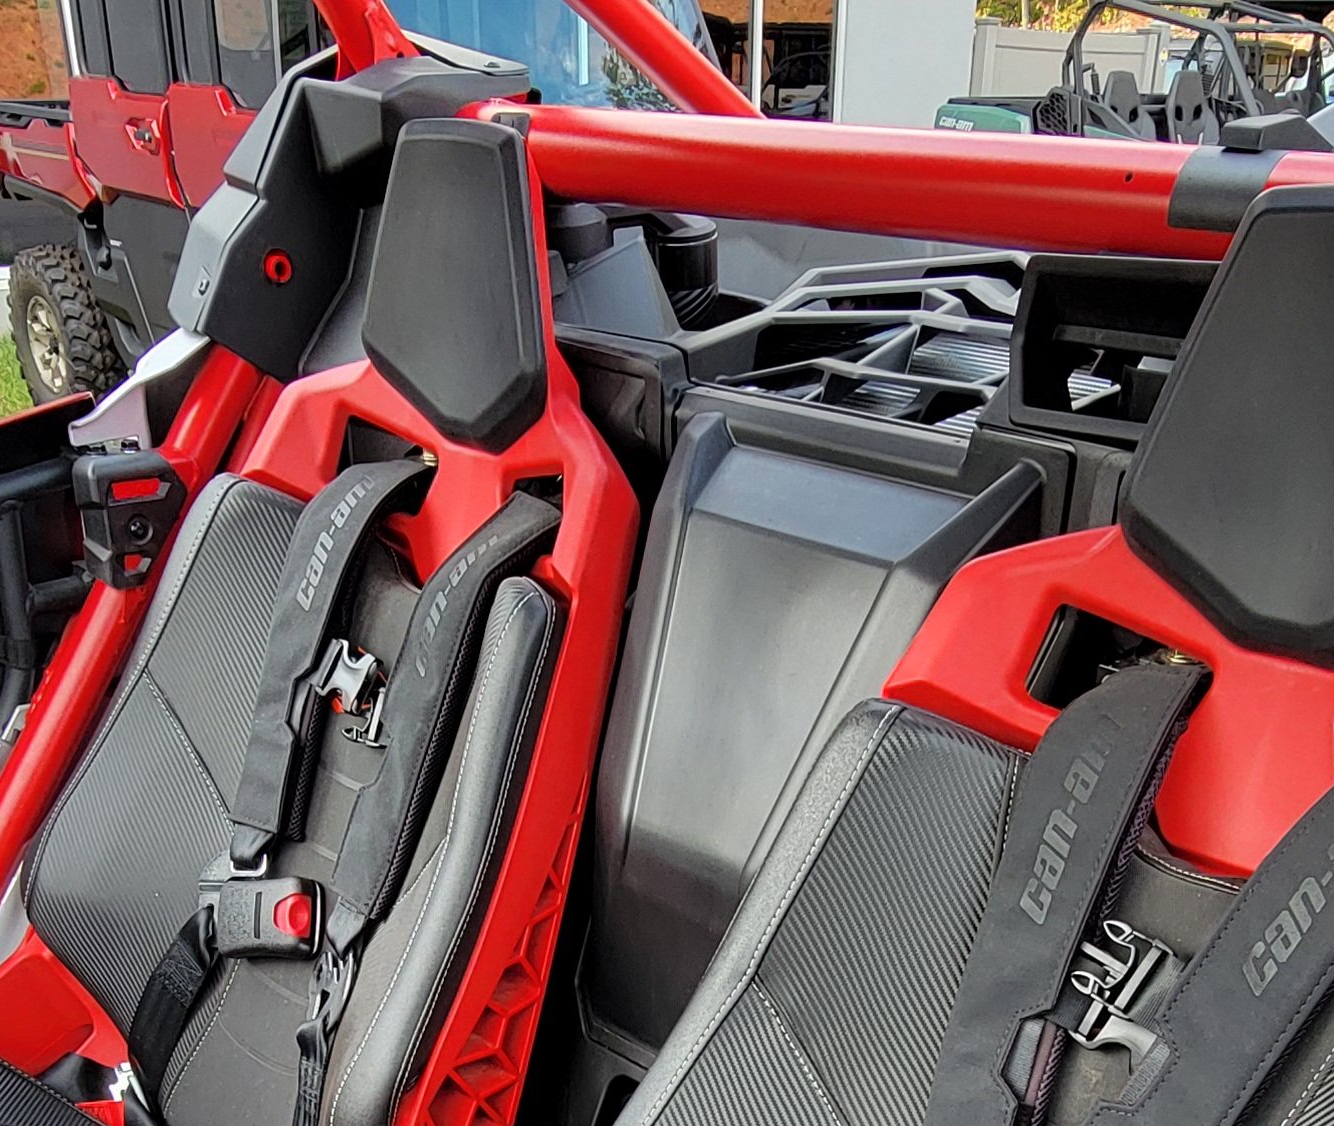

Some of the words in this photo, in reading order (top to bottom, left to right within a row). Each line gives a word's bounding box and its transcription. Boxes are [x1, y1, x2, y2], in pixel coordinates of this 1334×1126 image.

[939, 116, 974, 132] can-am
[296, 475, 376, 612] can-am
[1019, 712, 1123, 925] can-am
